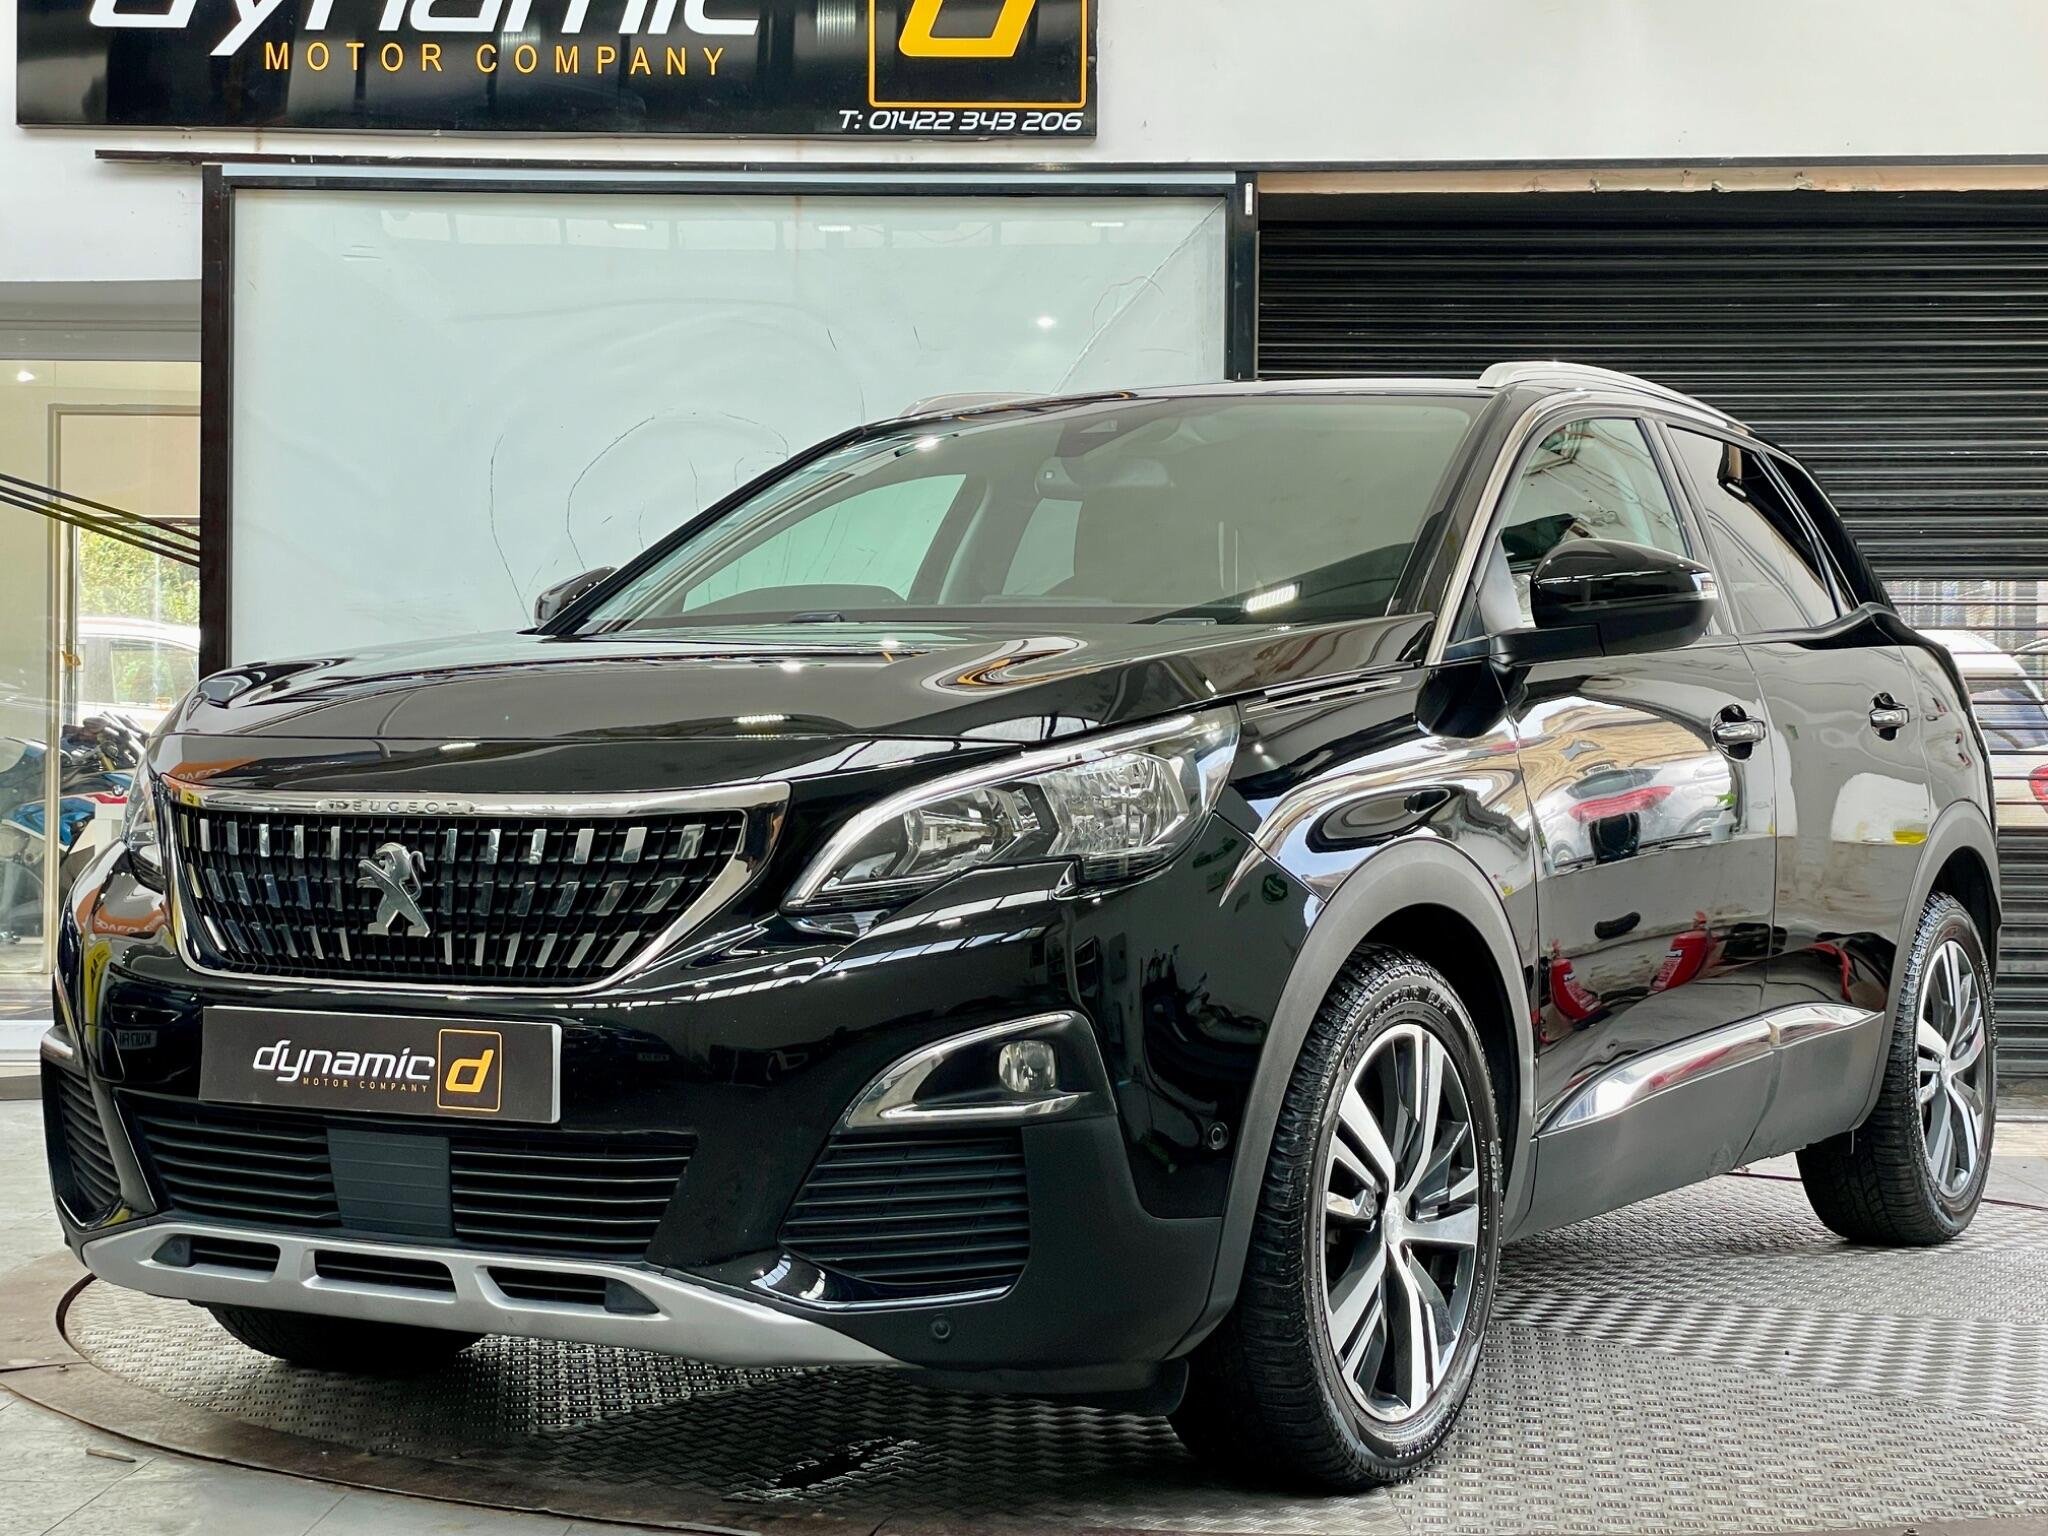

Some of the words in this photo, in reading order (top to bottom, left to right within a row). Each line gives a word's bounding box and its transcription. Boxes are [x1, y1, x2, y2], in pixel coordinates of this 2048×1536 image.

[264, 41, 442, 72] MOTOR
[475, 43, 725, 76] COMPANY
[838, 109, 863, 130] T:
[868, 110, 954, 131] 01422
[958, 111, 1016, 131] 343
[1020, 111, 1084, 131] 206
[329, 800, 459, 814] PEUGEOT
[252, 1039, 436, 1083] dynamic
[302, 1076, 349, 1089] MOTOR
[359, 1081, 429, 1093] COMPANY
